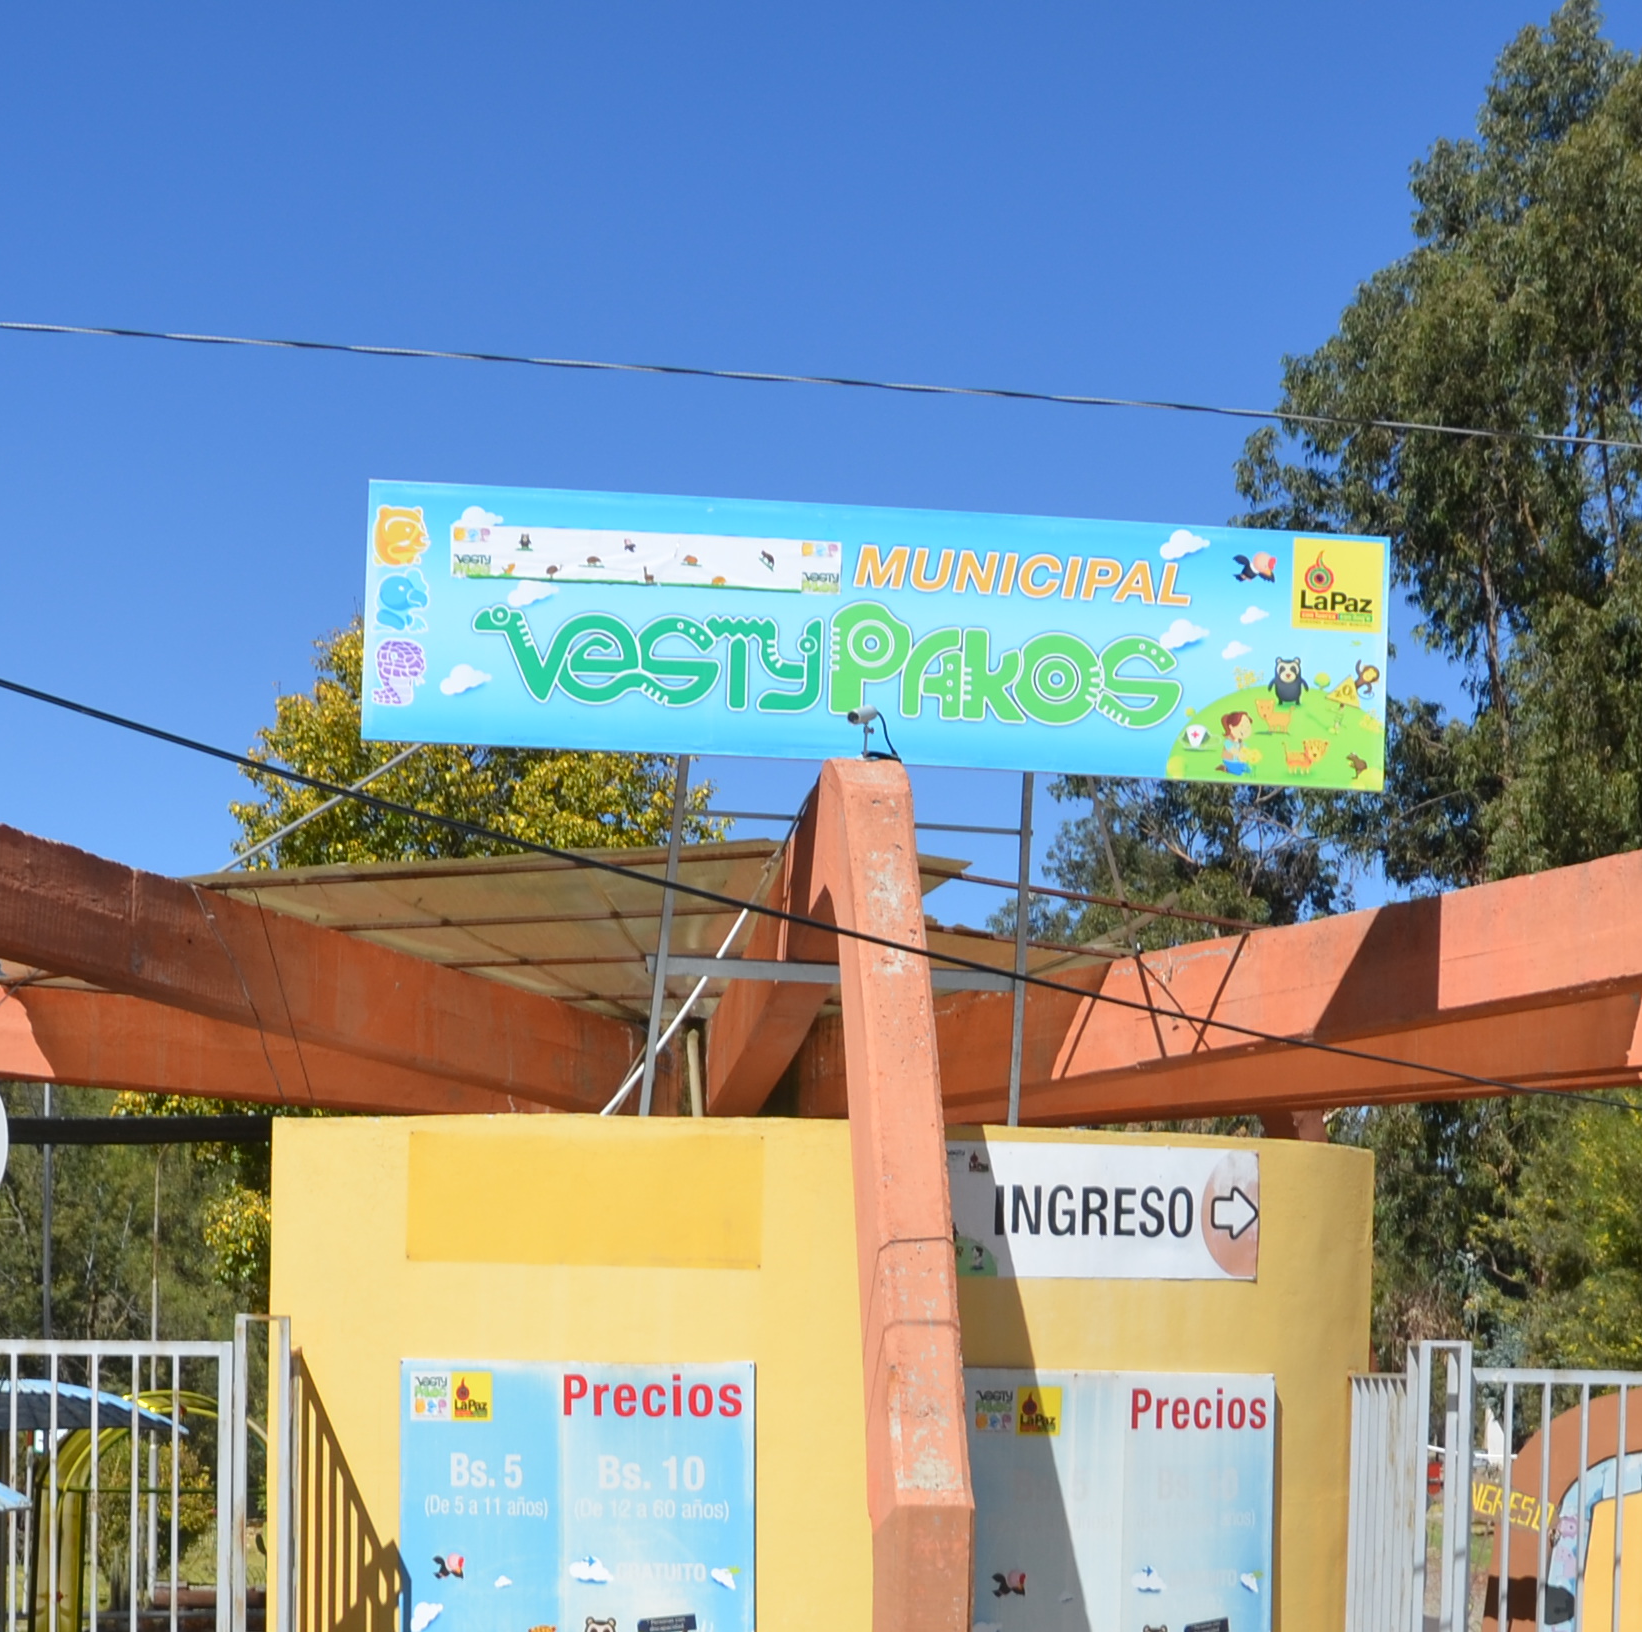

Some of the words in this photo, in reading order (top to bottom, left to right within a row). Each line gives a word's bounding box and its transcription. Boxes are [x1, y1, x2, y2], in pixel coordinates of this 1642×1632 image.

[853, 544, 1191, 606] MUNICIPAL
[994, 1184, 1194, 1239] INGRESO
[563, 1373, 743, 1417] Precios
[1131, 1388, 1267, 1430] Precios
[450, 1452, 495, 1488] Bs.
[504, 1454, 522, 1488] 5
[598, 1455, 651, 1490] Bs.
[662, 1455, 705, 1491] 10
[454, 1497, 464, 1514] 5
[469, 1501, 478, 1514] a
[484, 1497, 501, 1515] 11
[636, 1504, 647, 1518] a
[654, 1499, 675, 1518] 60
[615, 1562, 707, 1582] GRATUITO
